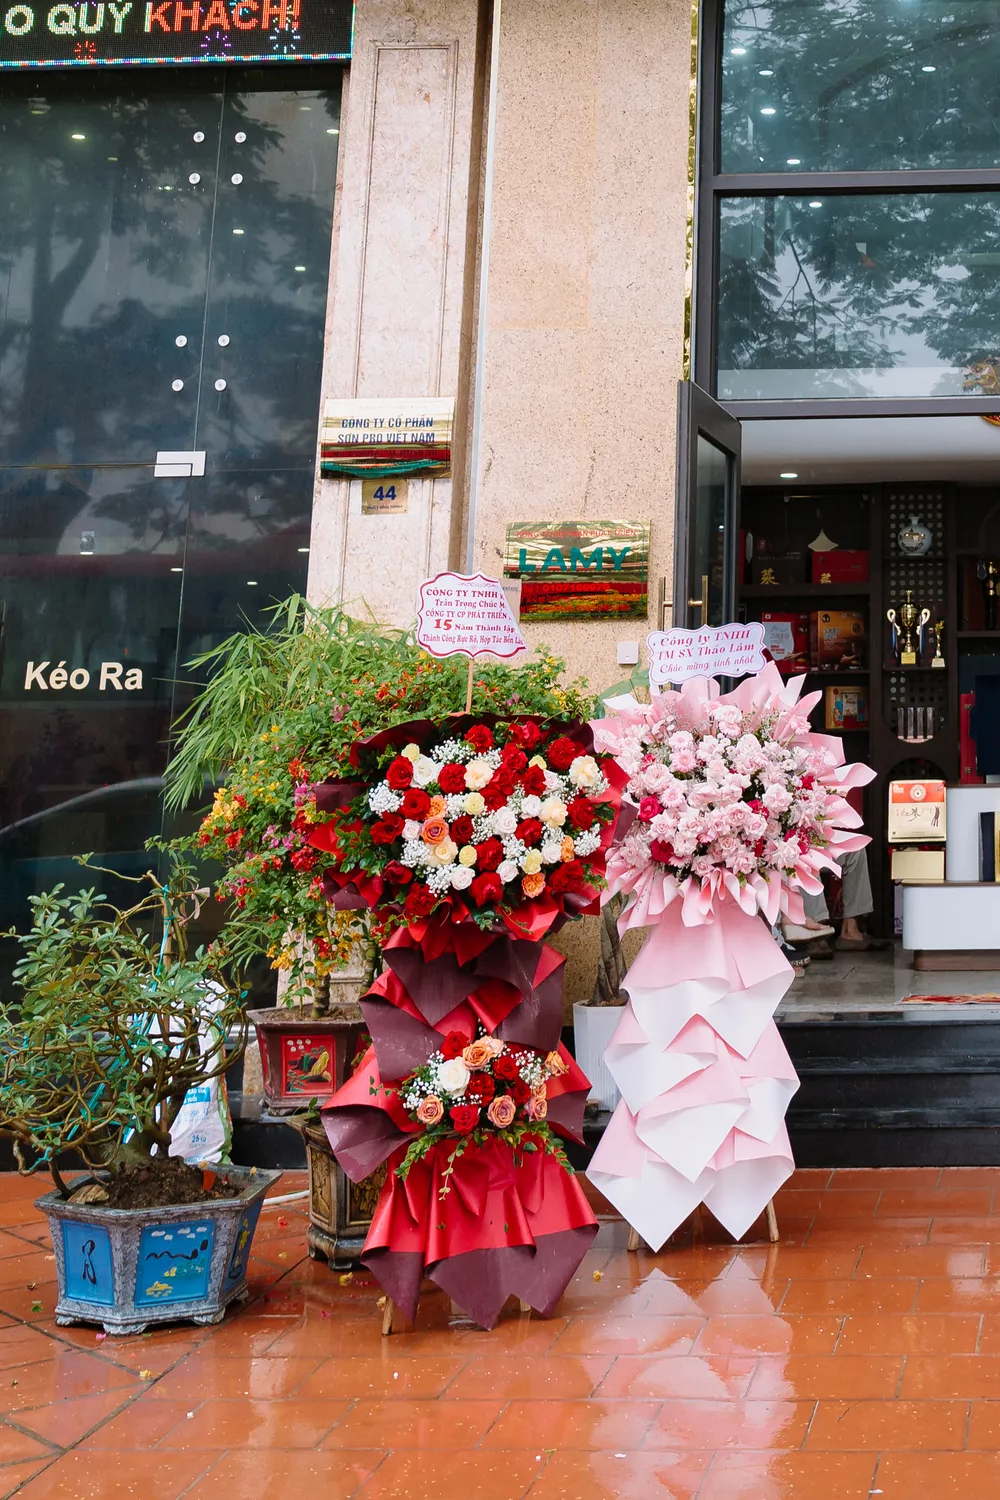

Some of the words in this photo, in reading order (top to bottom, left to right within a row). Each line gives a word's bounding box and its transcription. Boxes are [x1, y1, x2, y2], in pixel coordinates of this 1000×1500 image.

[342, 416, 370, 428] CÔNG
[374, 418, 385, 428] TY
[388, 414, 403, 428] CỔ
[405, 414, 433, 428] PHẦN
[411, 433, 435, 443] NAM
[373, 486, 396, 500] 44
[518, 546, 631, 572] LAMY
[426, 587, 453, 596] CÔNG
[456, 589, 468, 597] TY
[471, 590, 498, 598] TNHH
[455, 599, 476, 609] Trọng
[479, 599, 497, 608] Chúc
[426, 609, 444, 617] CÔNG
[467, 610, 485, 619] PHÁT
[433, 619, 453, 630] 15
[423, 633, 440, 641] Thành
[441, 634, 455, 644] Công
[493, 635, 502, 644] Tác
[661, 634, 693, 647] Công
[698, 635, 710, 645] ty
[714, 630, 751, 641] TNHH
[658, 649, 675, 660] TM
[678, 648, 694, 659] SX
[729, 642, 755, 653] Lâm
[660, 663, 682, 674] Chúc
[686, 661, 709, 672] mừng
[713, 656, 731, 667] sinh
[24, 661, 90, 690] Kéo
[99, 662, 143, 690] Ra
